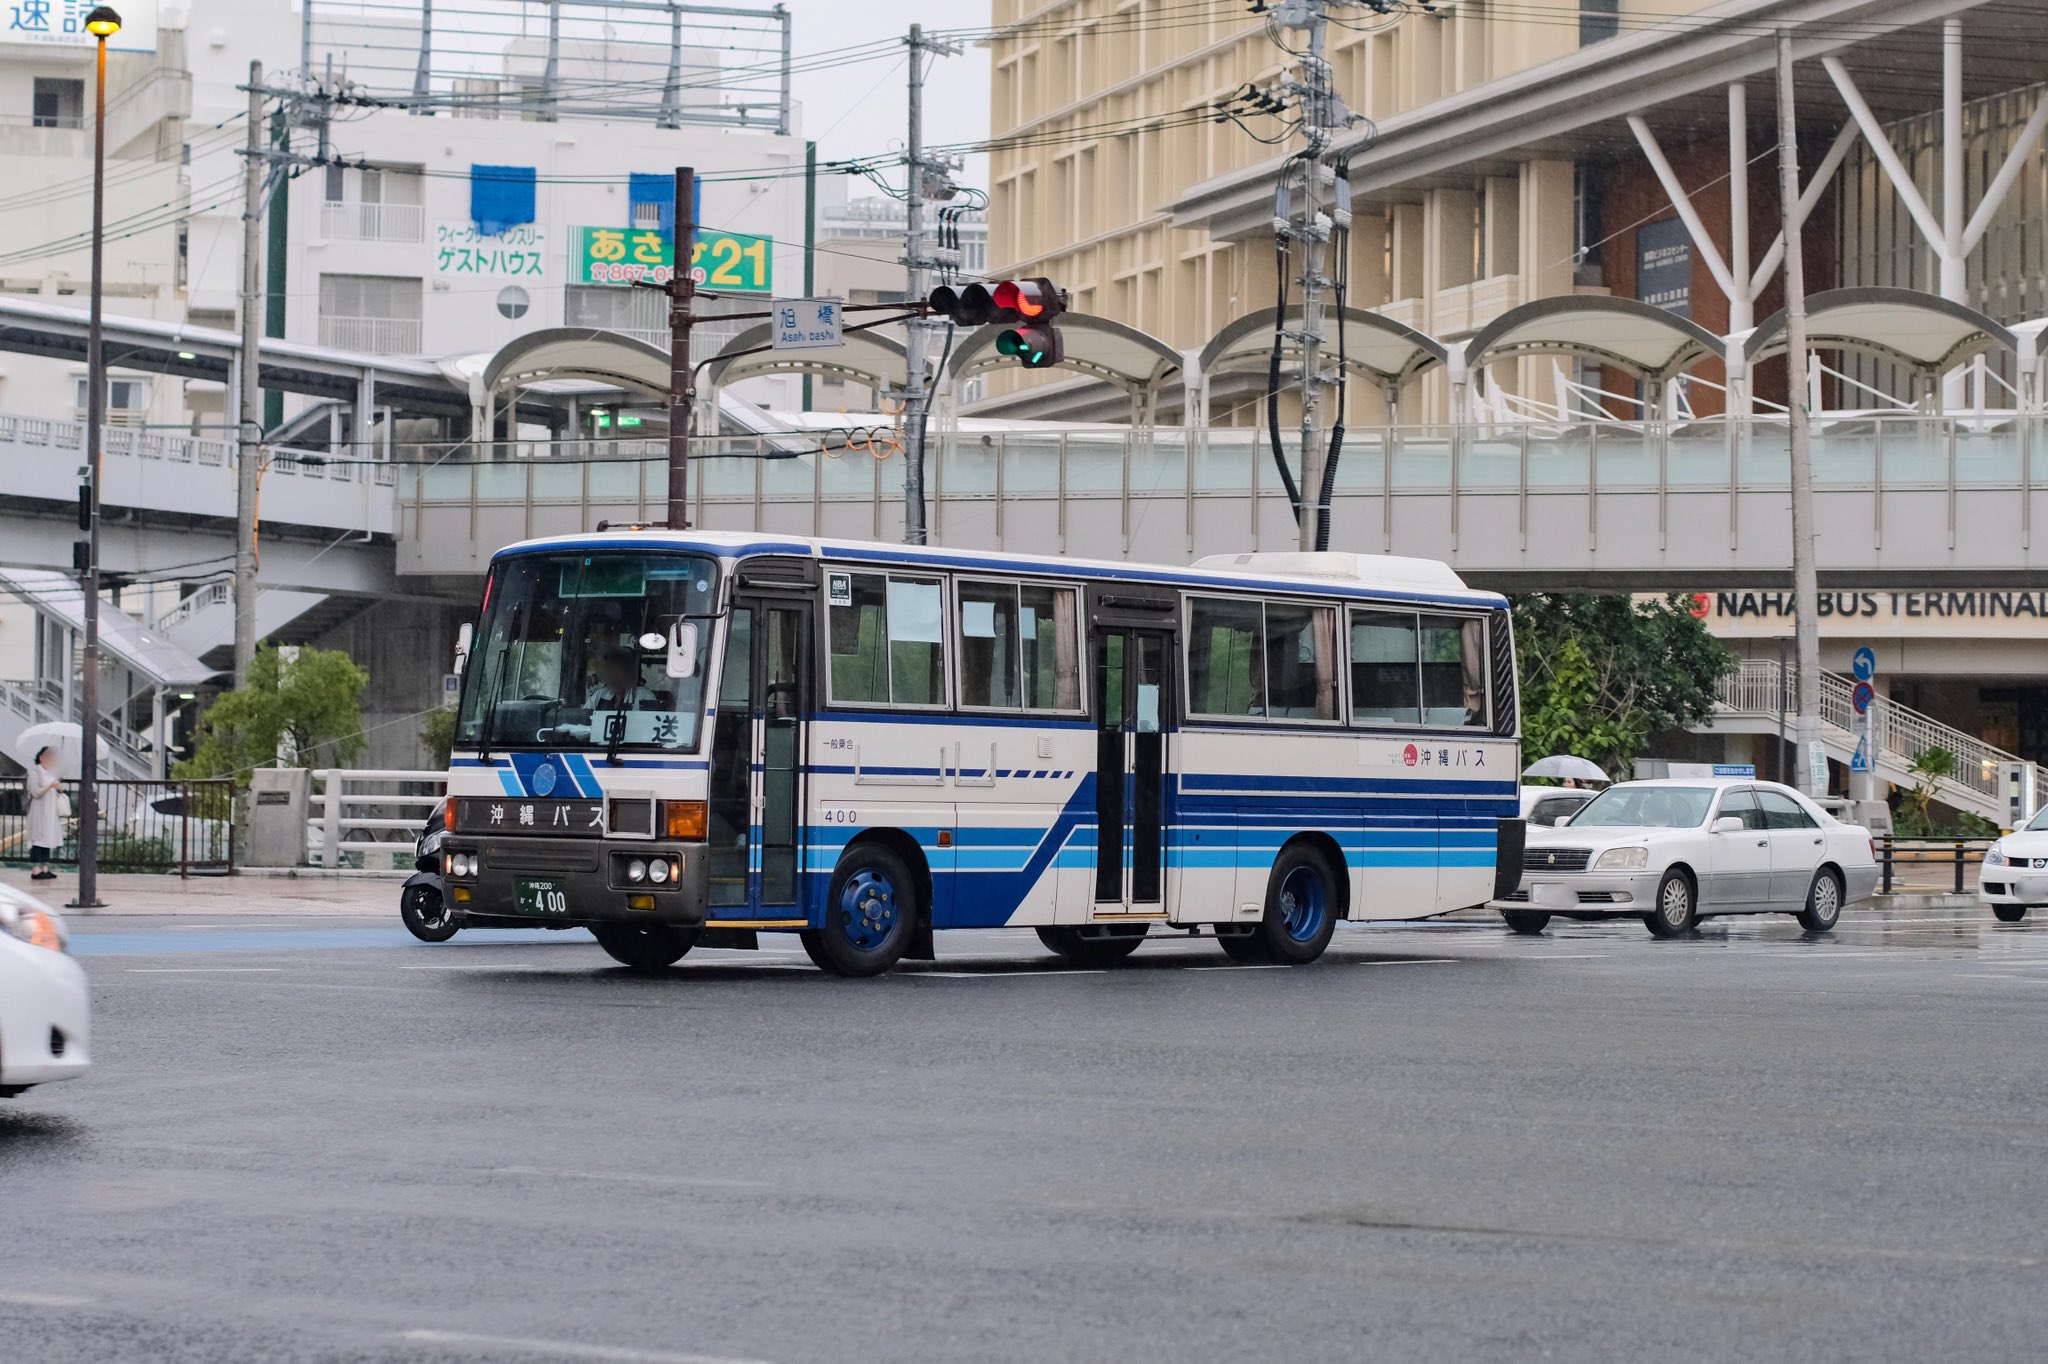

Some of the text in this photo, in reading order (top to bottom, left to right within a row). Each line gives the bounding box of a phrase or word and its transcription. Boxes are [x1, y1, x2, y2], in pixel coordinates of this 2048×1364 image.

[438, 247, 543, 275] ゲストハウス
[610, 263, 706, 285] 867-09
[780, 305, 834, 328] 旭橋
[833, 580, 847, 590] NBA
[1817, 592, 1878, 617] BUS
[604, 714, 679, 743] 回送
[1421, 749, 1485, 767] 沖縄バス
[491, 804, 604, 828] 沖縄バス
[825, 810, 857, 824] 400
